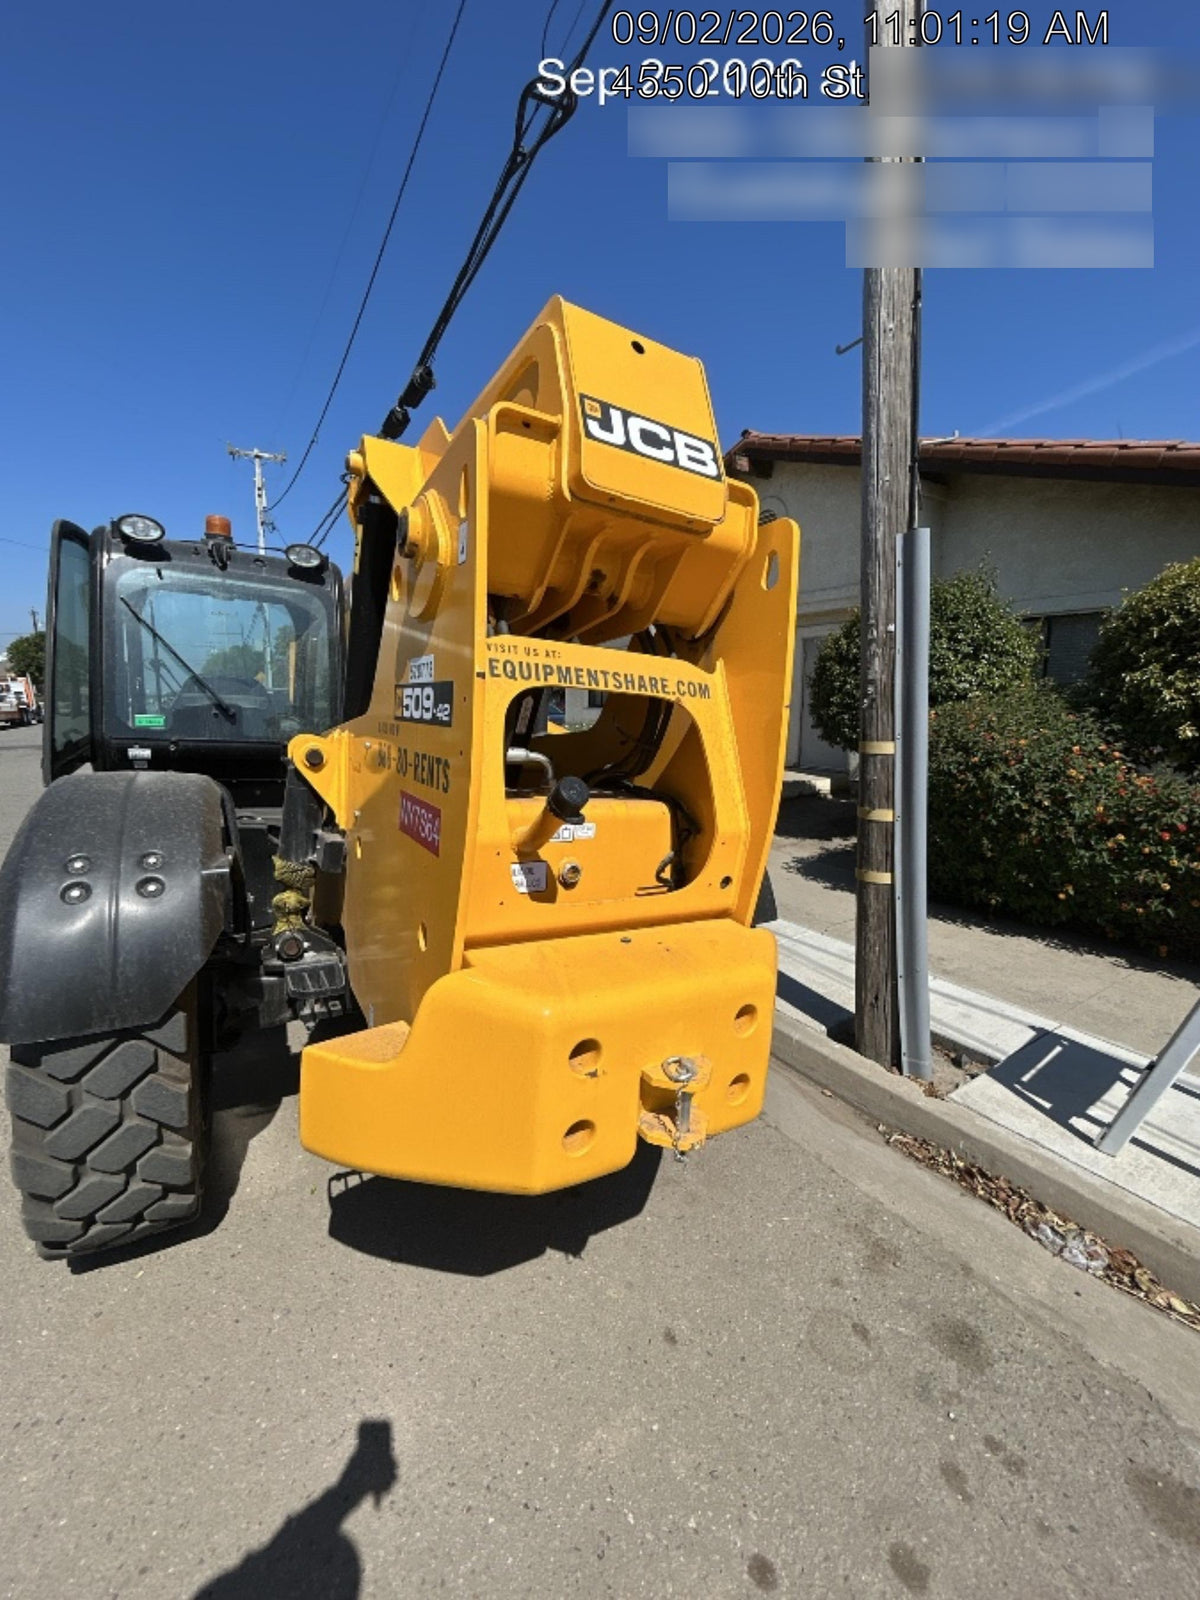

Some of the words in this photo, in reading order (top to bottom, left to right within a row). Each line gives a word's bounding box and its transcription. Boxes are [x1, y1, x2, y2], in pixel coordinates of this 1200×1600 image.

[586, 407, 718, 477] JCB
[486, 642, 518, 655] VISIT
[524, 646, 540, 657] US
[544, 649, 561, 659] AT:
[487, 658, 711, 699] EQUIPMENTSHARE.COM
